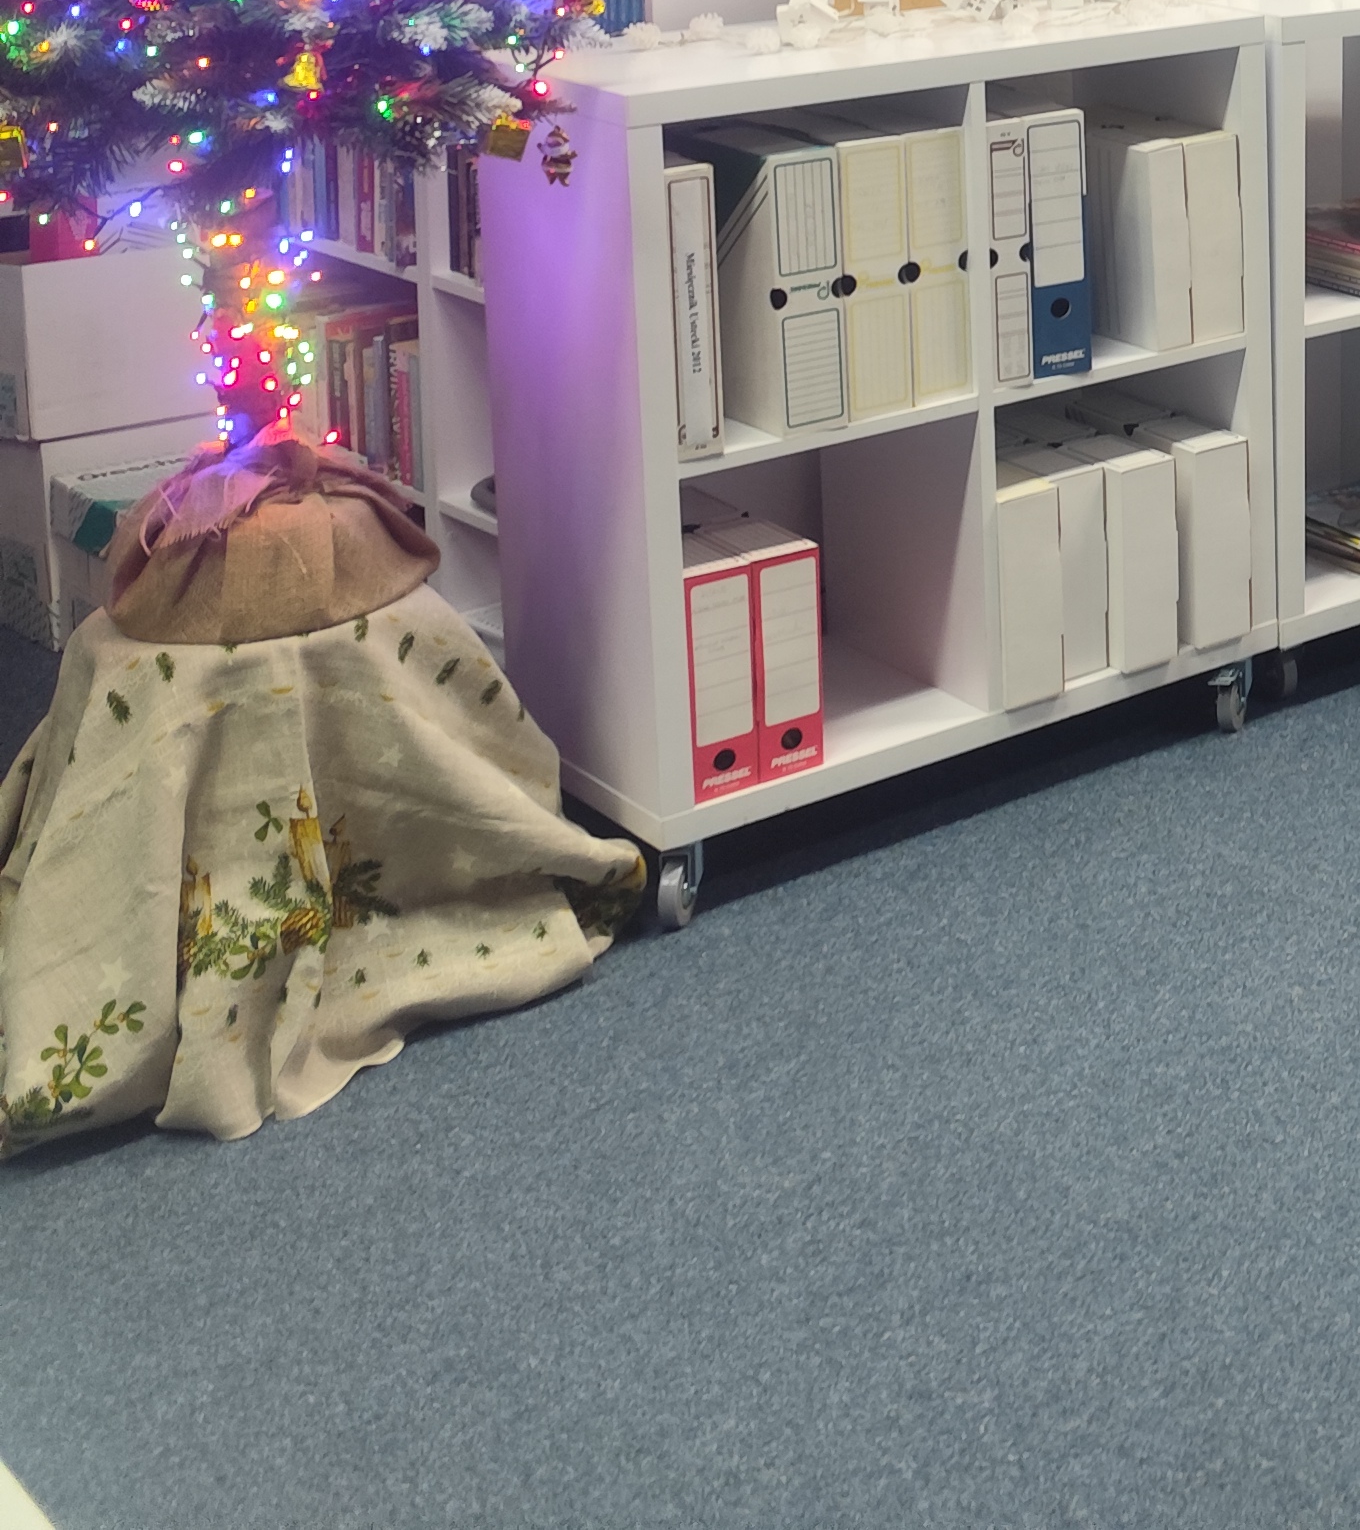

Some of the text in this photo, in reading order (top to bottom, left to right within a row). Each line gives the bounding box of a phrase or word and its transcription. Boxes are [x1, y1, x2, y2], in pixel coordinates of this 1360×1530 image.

[1041, 348, 1086, 366] PRESSEL
[771, 745, 818, 769] PRESSEL
[702, 766, 752, 790] PRESSEL
